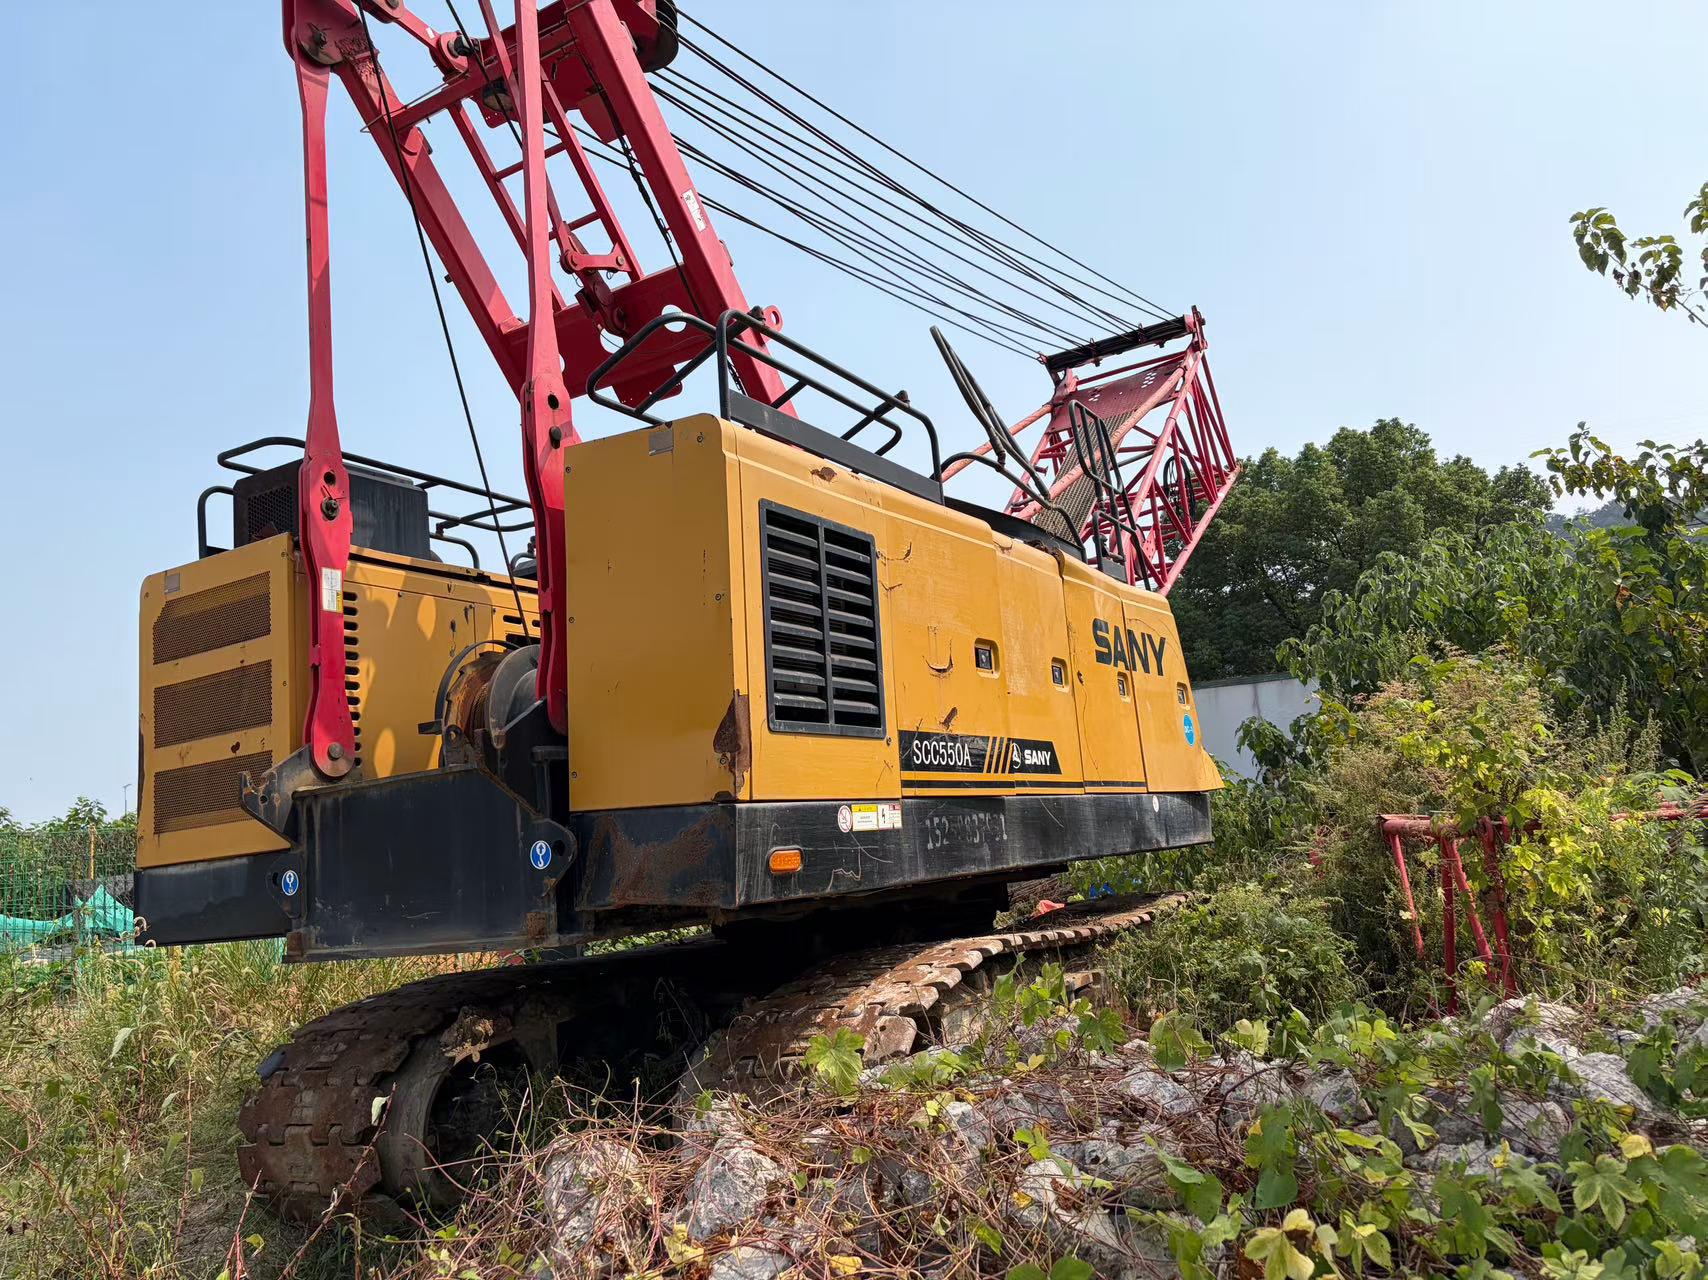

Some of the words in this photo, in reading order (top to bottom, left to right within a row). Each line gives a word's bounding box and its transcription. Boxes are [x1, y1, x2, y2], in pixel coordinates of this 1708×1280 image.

[1092, 617, 1166, 677] SANY
[913, 740, 972, 767] SCC550A
[1024, 749, 1051, 766] SANY
